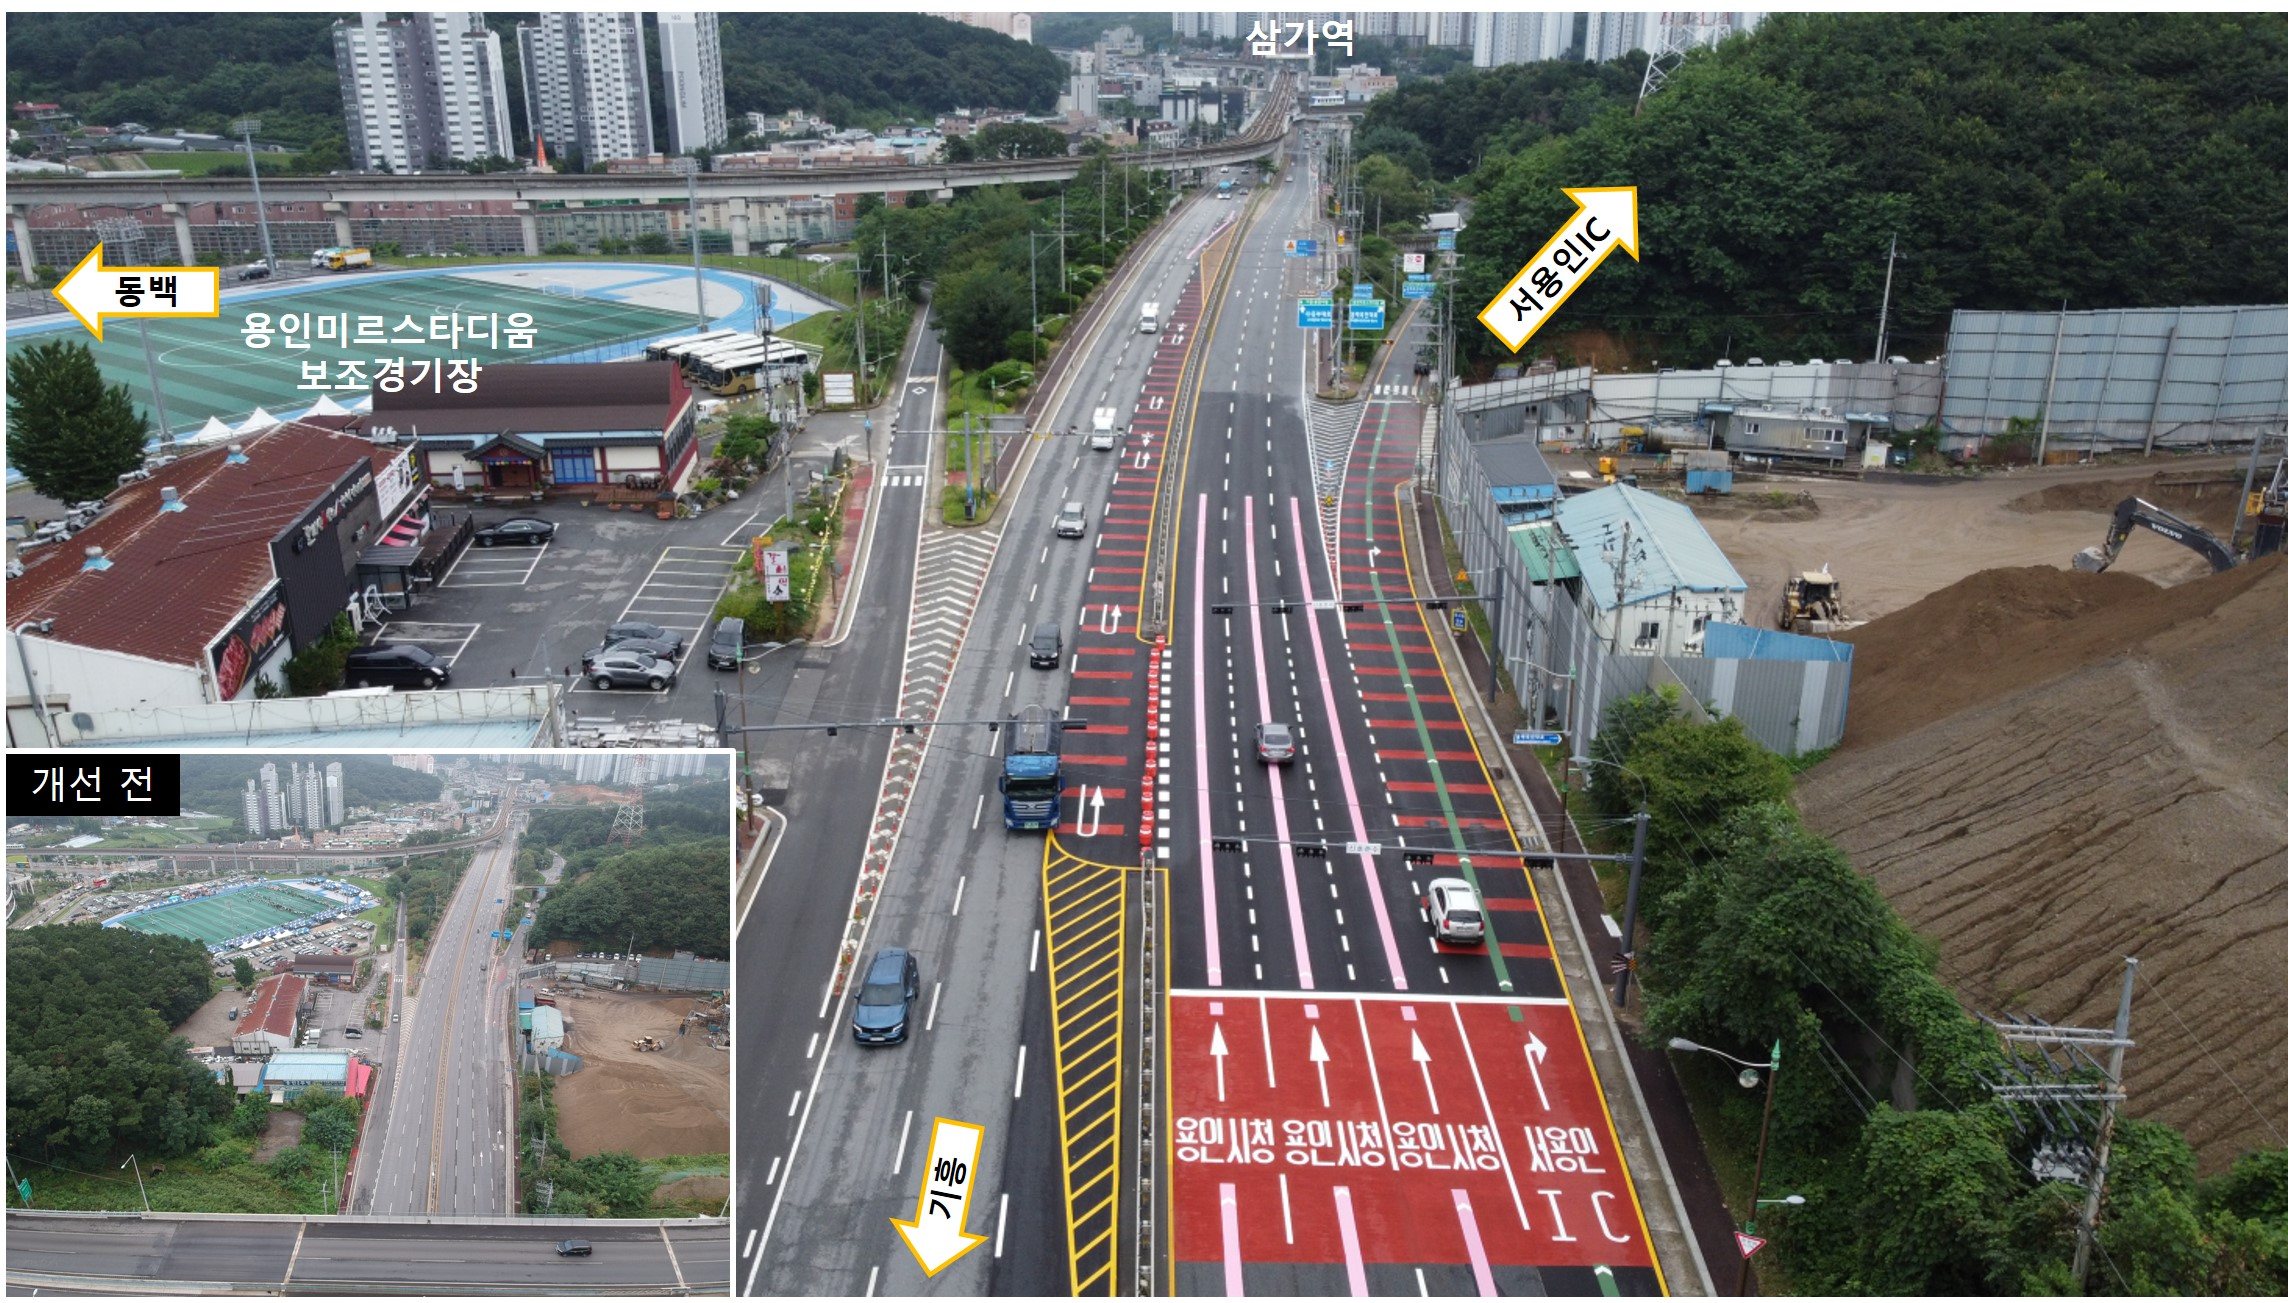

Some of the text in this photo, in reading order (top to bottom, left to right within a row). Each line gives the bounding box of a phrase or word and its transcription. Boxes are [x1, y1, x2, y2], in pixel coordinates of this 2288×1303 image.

[2151, 522, 2183, 539] VOLVO
[1175, 1116, 1275, 1164] 용인시청
[1282, 1118, 1385, 1168] 용인시청
[1391, 1120, 1501, 1171] 용인시청
[1523, 1125, 1606, 1174] 서용인
[1538, 1189, 1630, 1243] IC
